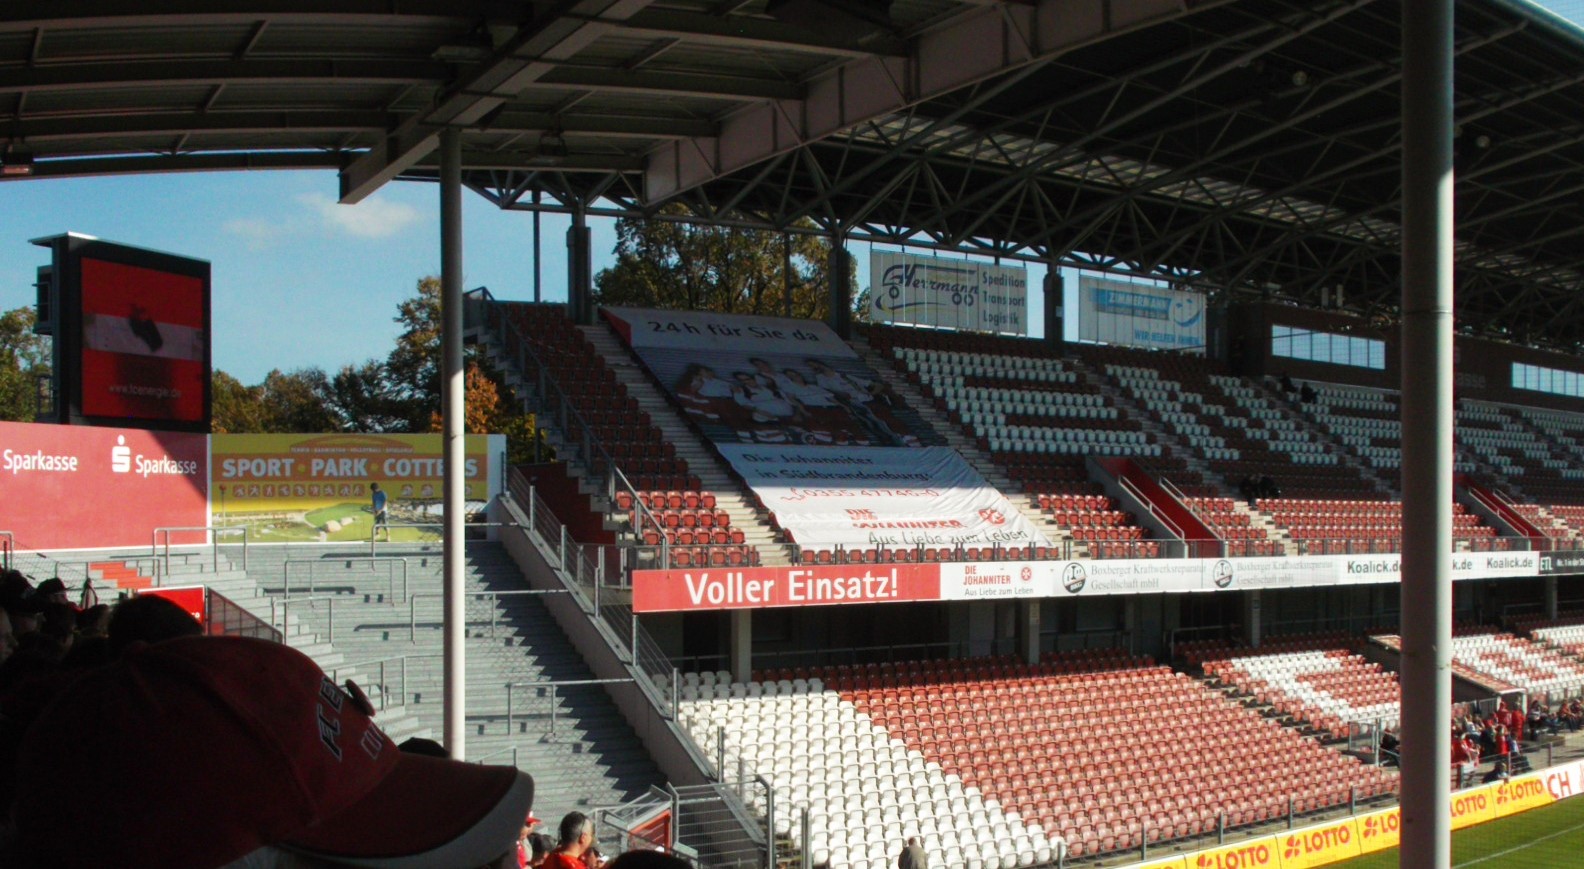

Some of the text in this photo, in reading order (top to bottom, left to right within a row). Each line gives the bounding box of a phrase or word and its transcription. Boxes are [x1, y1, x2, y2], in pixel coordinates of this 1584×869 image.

[900, 264, 980, 295] Herrmann
[983, 272, 1025, 287] Spedition
[983, 291, 1025, 306] Transport
[983, 310, 1019, 326] Logistik
[707, 324, 741, 336] für
[748, 327, 786, 339] Sie
[792, 329, 820, 341] da
[3, 449, 197, 478] Sparkasse Sparkasse
[742, 454, 874, 465] Die Johanniter
[222, 458, 478, 478] SPORT PARK COTTS
[755, 469, 778, 479] in
[868, 532, 898, 545] Aus
[902, 531, 943, 545] Liebe
[984, 529, 1029, 543] Leben
[965, 565, 977, 575] DIE
[1091, 565, 1131, 576] Boxberger
[1486, 557, 1533, 569] Koalick.de
[684, 568, 898, 605] Voller Einsatz!
[963, 575, 1011, 586] JOHANNITER
[1091, 578, 1138, 590] Gesellschaft
[965, 588, 977, 596] Aus
[980, 587, 996, 596] Liebe
[1014, 587, 1034, 595] Leben
[1510, 780, 1544, 801] LOTTO
[1304, 825, 1350, 851] LOTTO
[1216, 844, 1270, 869] LOTTO
